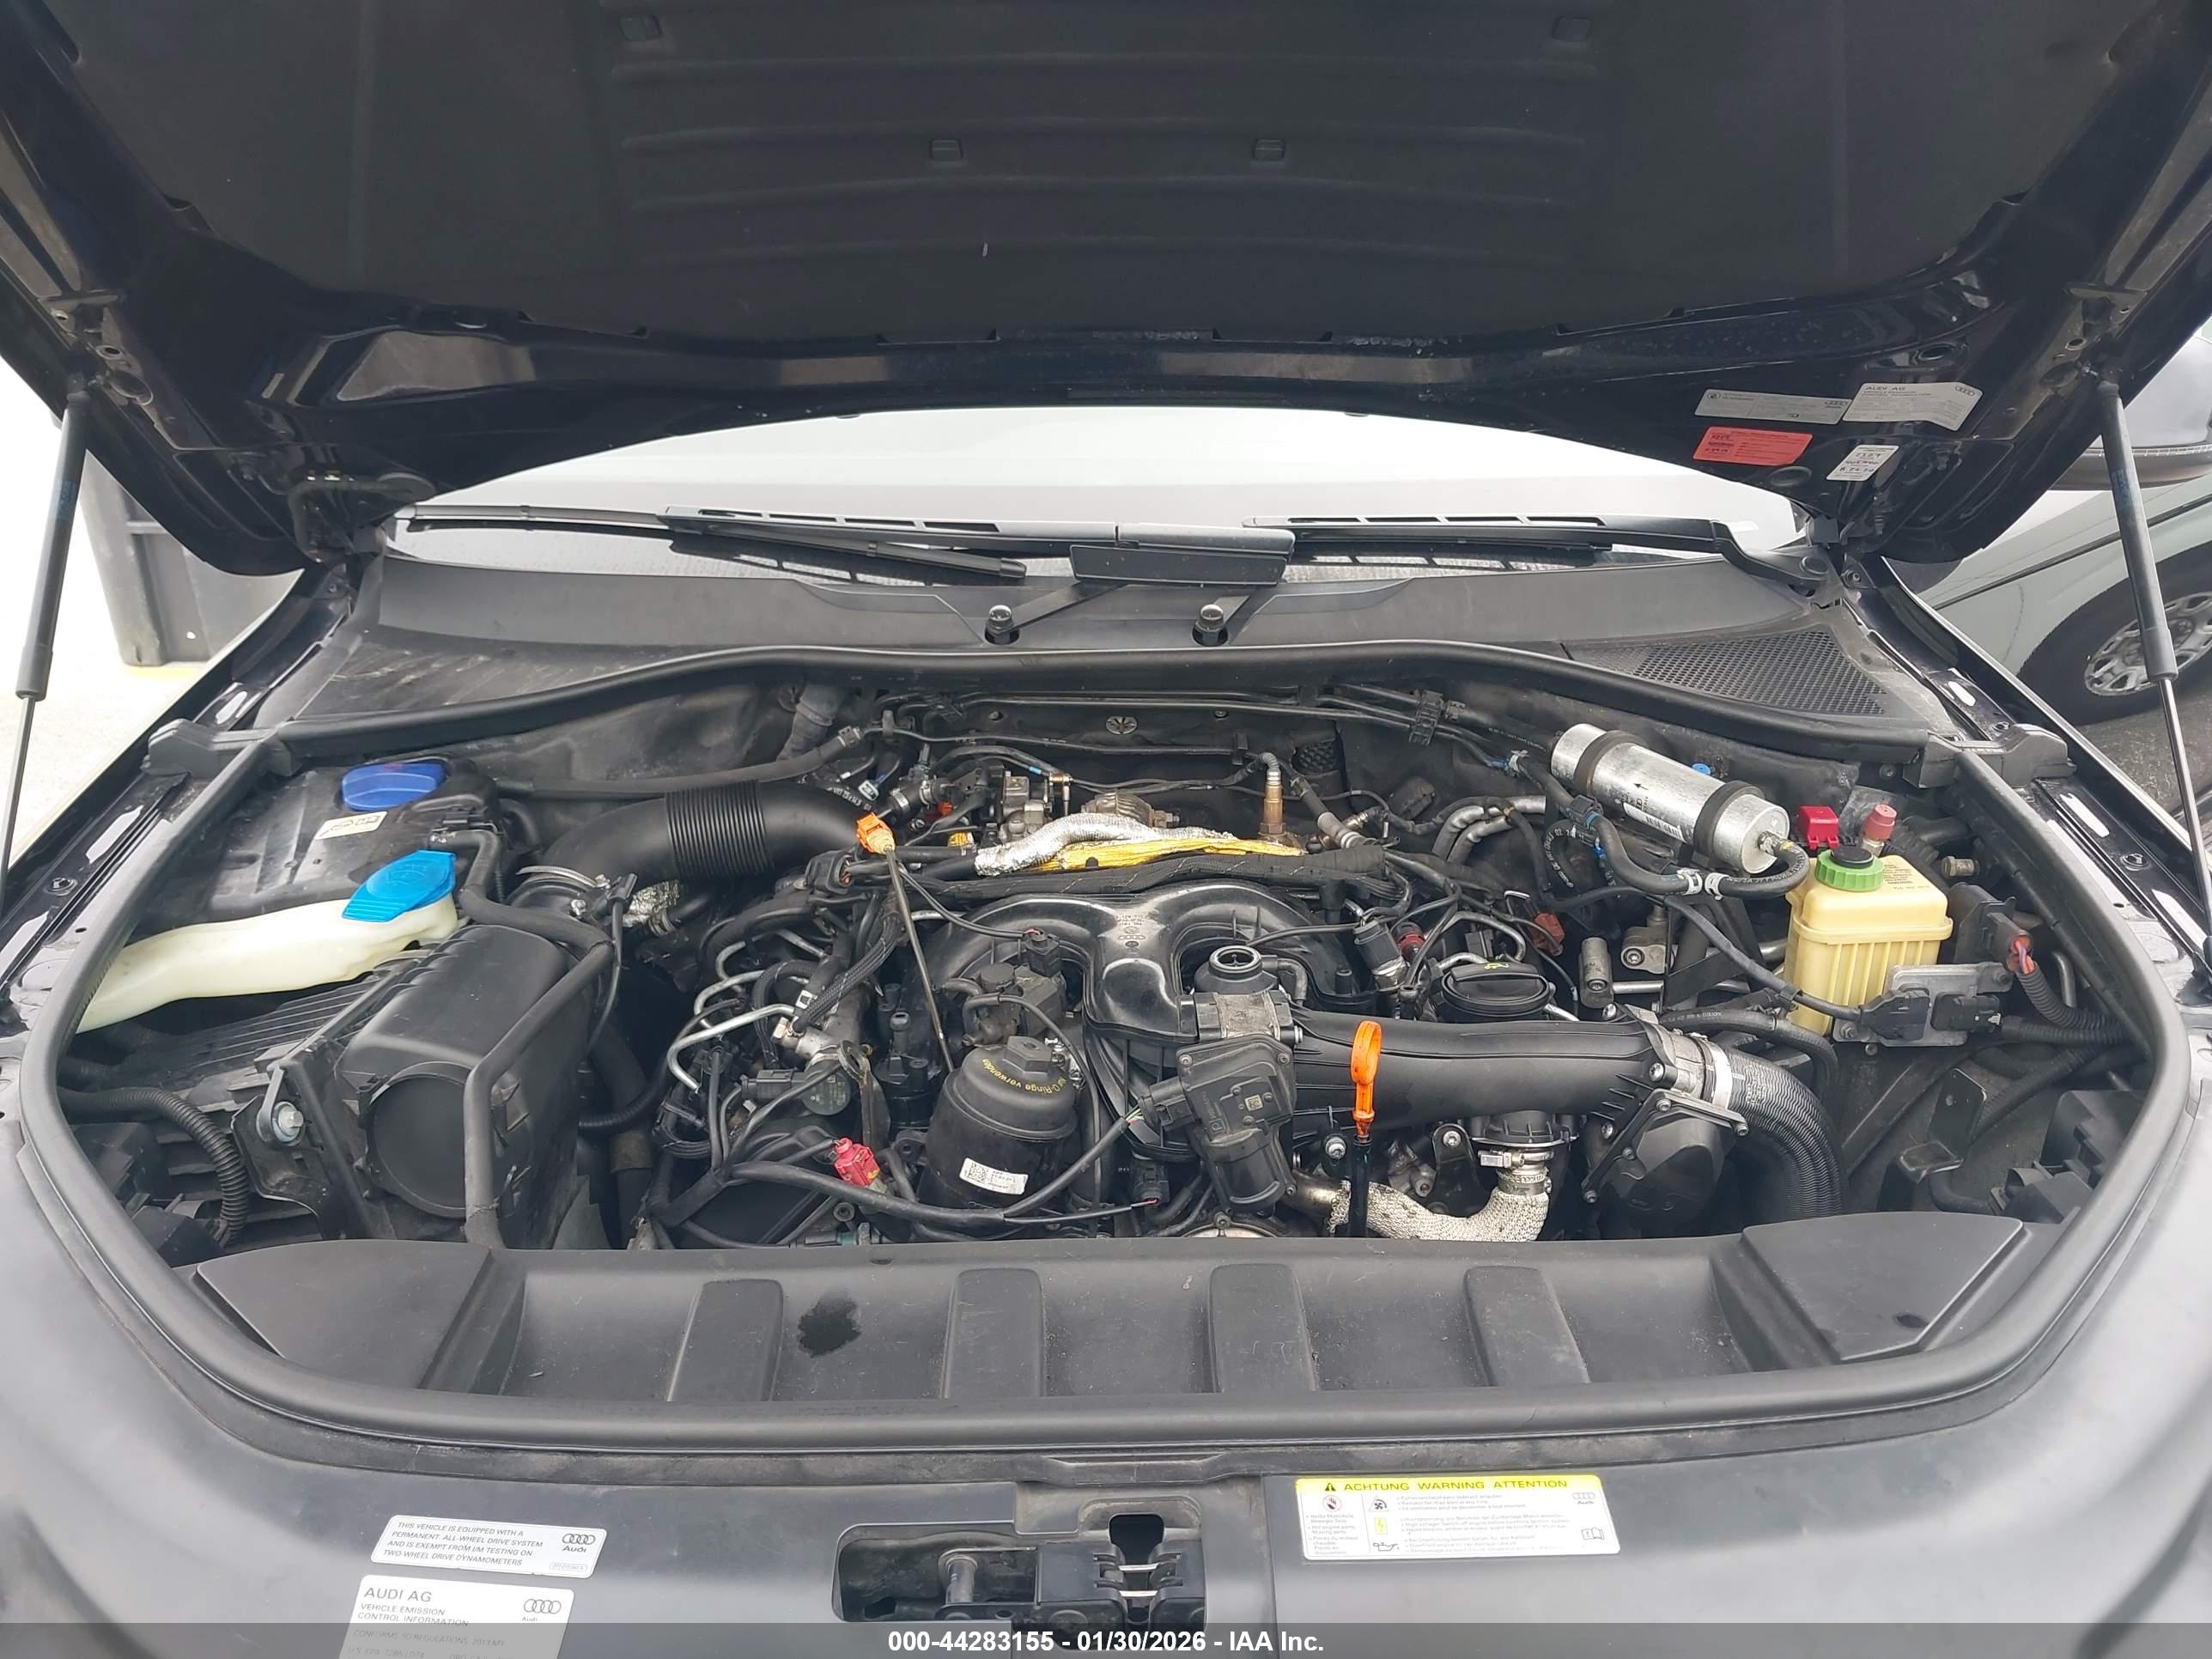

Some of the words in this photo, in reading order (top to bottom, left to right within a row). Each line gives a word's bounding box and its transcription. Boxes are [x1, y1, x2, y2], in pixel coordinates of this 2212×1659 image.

[1344, 1482, 1409, 1492] ACHTUNG
[1418, 1481, 1485, 1490] WARNING
[1493, 1480, 1568, 1489] ATTENTION
[457, 1526, 495, 1534] EQUIPPED
[392, 1531, 440, 1540] PERMANENT
[442, 1534, 485, 1543] ALL-WHEEL
[512, 1539, 544, 1547] SYSTEM
[384, 1549, 429, 1559] TWO-WHEEL
[432, 1553, 455, 1561] DRIVE
[456, 1554, 523, 1566] DYNAMOMETERS
[486, 1547, 519, 1556] TESTING
[363, 1587, 404, 1600] AUDI
[407, 1590, 432, 1602] AG
[361, 1602, 397, 1613] VEHICLE
[399, 1606, 446, 1616] EMISSION
[357, 1612, 400, 1622] CONTROL
[404, 1615, 469, 1627] INFORMATION
